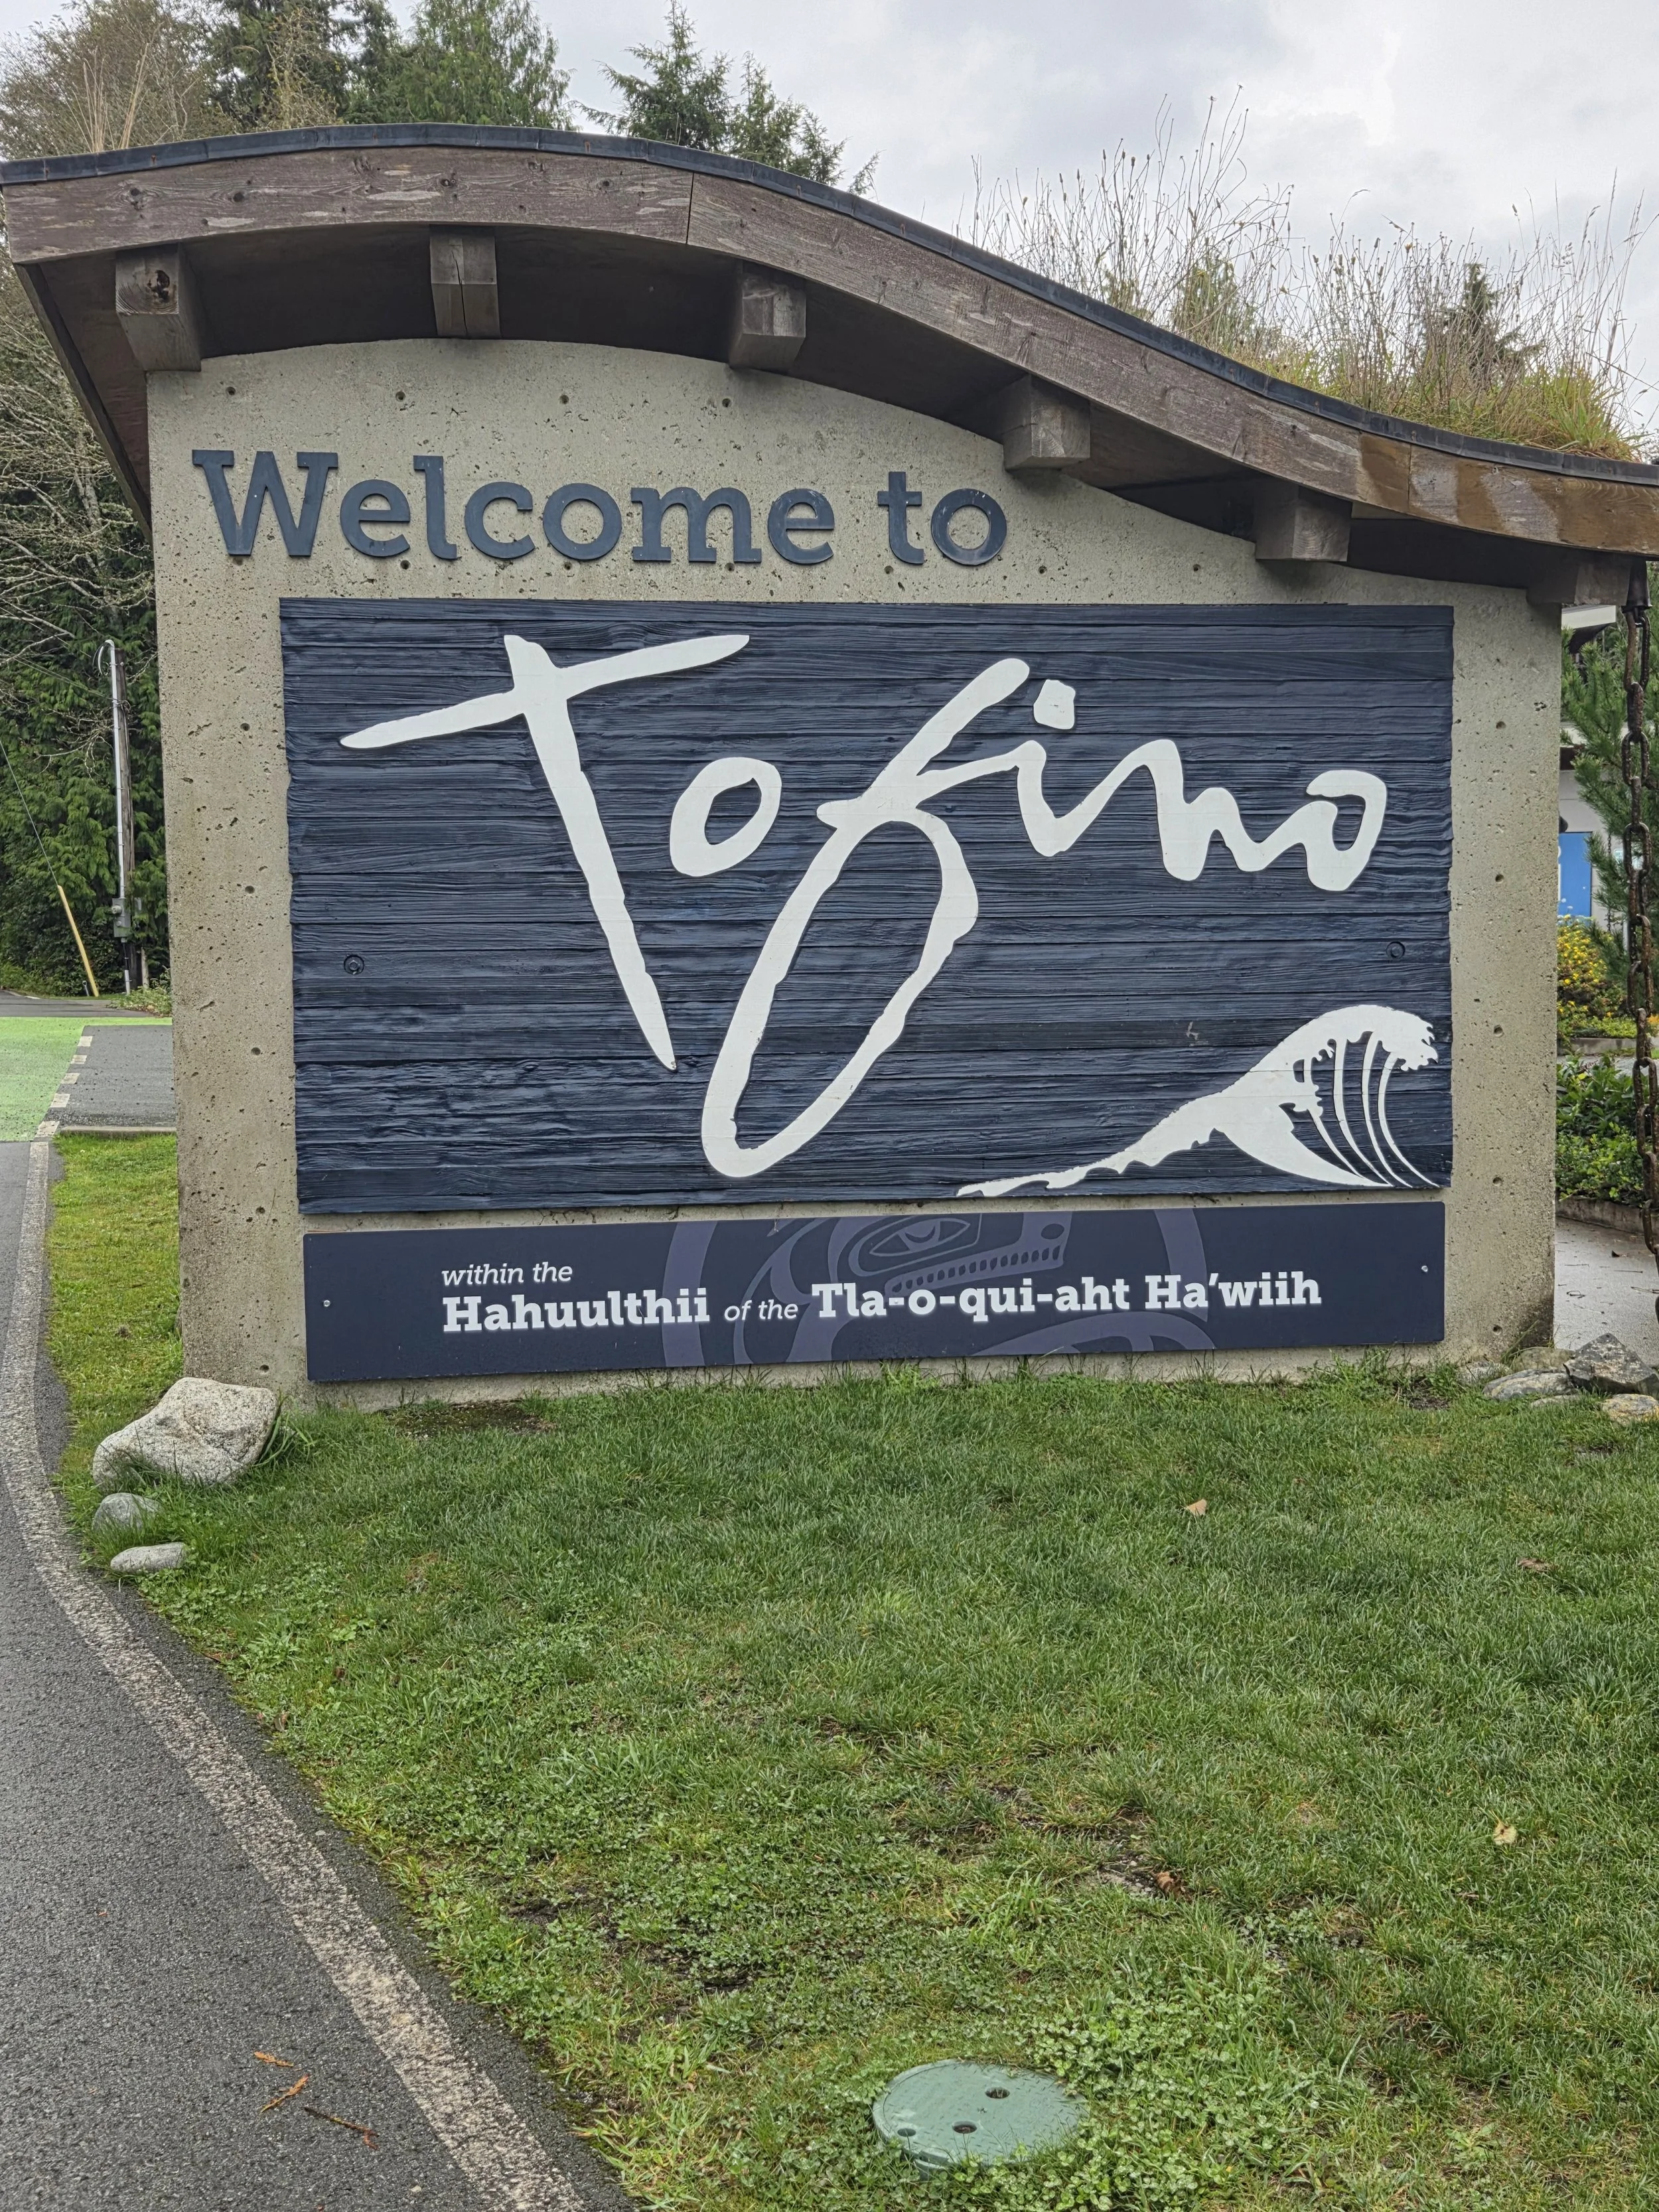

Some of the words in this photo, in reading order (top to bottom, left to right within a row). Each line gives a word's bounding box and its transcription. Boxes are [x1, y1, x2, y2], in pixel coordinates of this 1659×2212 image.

[192, 449, 835, 571] Welcome
[877, 471, 1010, 571] to
[340, 635, 1386, 1177] Tofino
[441, 1263, 524, 1286] within
[532, 1261, 573, 1283] the
[443, 1287, 710, 1332] Hahuulthii
[724, 1300, 751, 1322] of
[758, 1299, 798, 1321] the
[812, 1276, 1131, 1322] Tla-o-qui-aht
[1145, 1271, 1323, 1310] Ha'wiih
